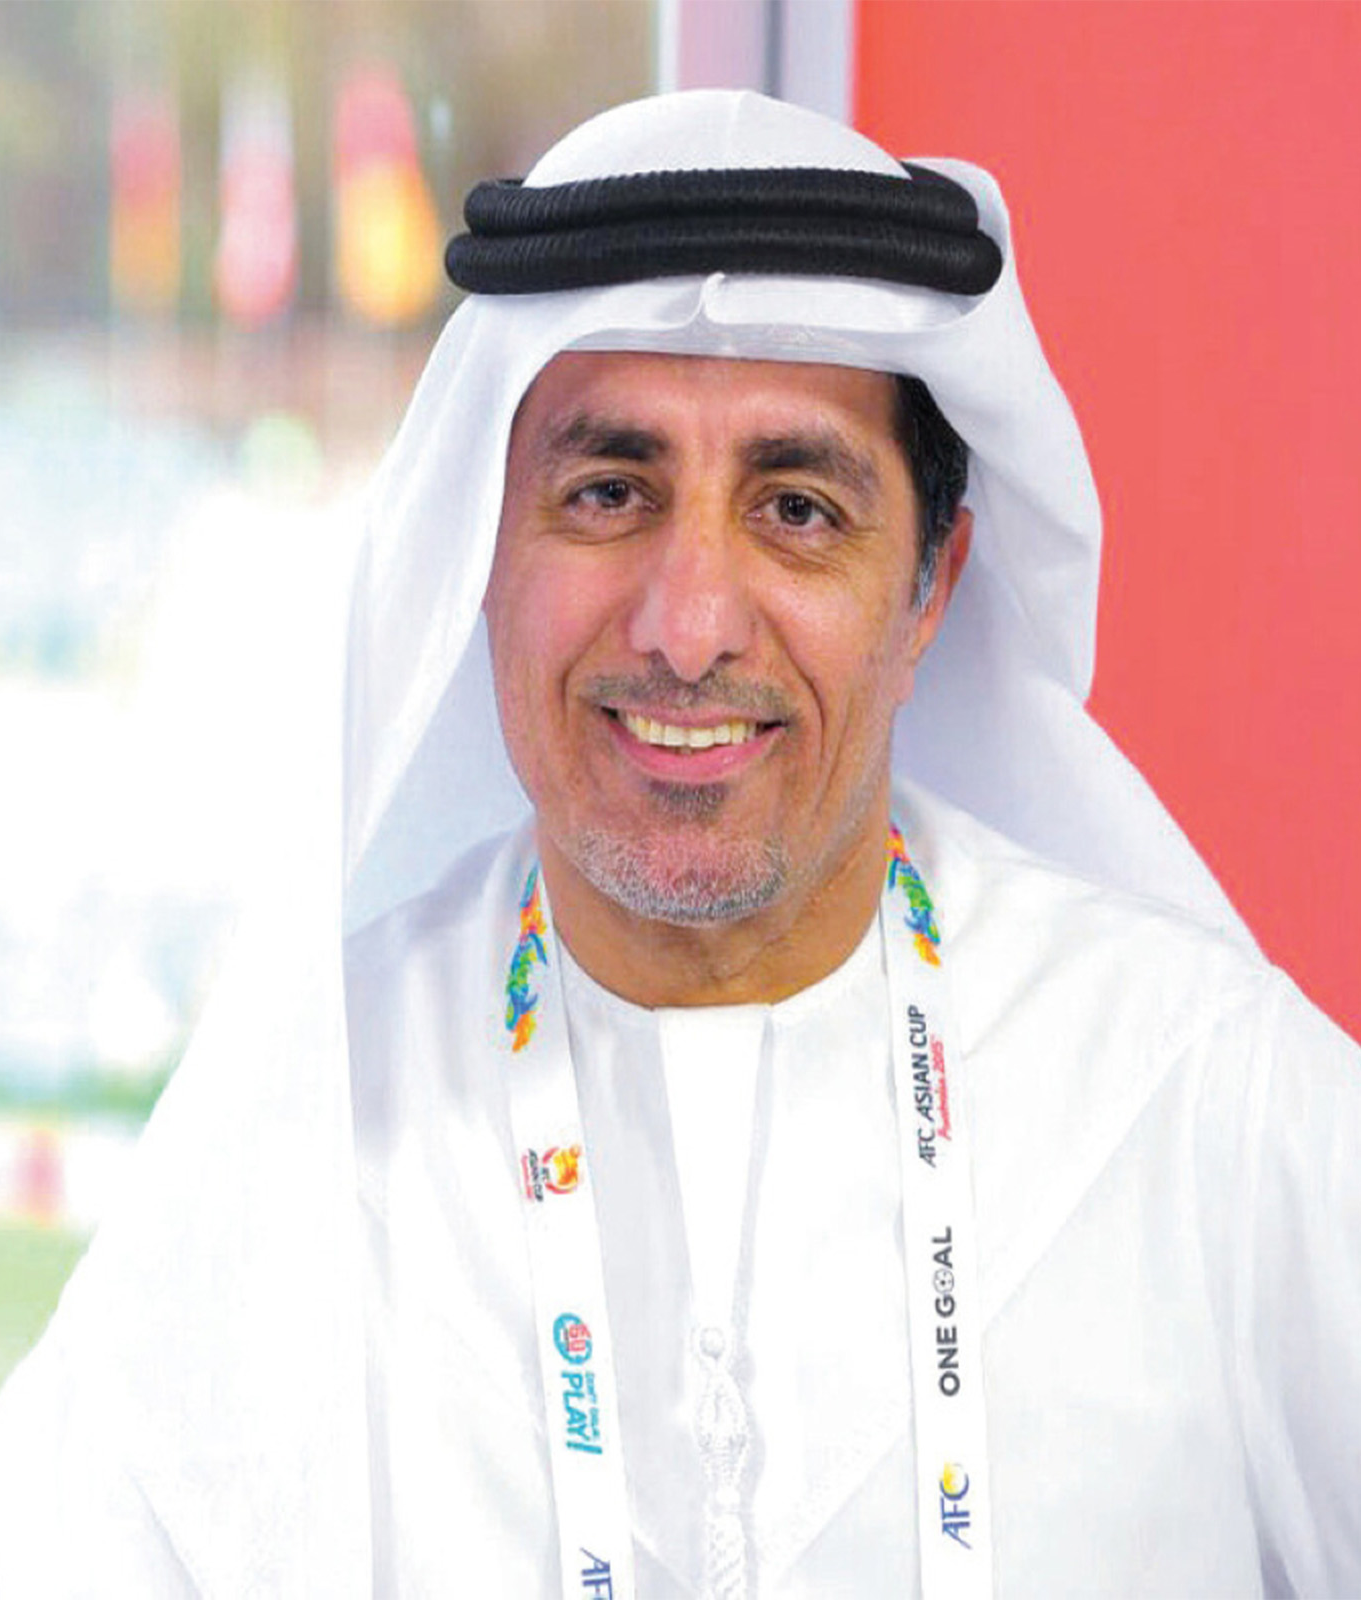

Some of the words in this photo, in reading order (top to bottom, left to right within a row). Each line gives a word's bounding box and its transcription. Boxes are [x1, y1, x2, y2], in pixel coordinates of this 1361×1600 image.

[907, 1004, 927, 1048] CUP
[911, 1053, 935, 1122] ASIAN
[917, 1128, 936, 1168] AFC
[932, 1226, 956, 1318] GOAL
[937, 1326, 960, 1397] ONE
[561, 1371, 603, 1454] PLAY!
[939, 1464, 972, 1550] AFC
[579, 1547, 613, 1600] AF
